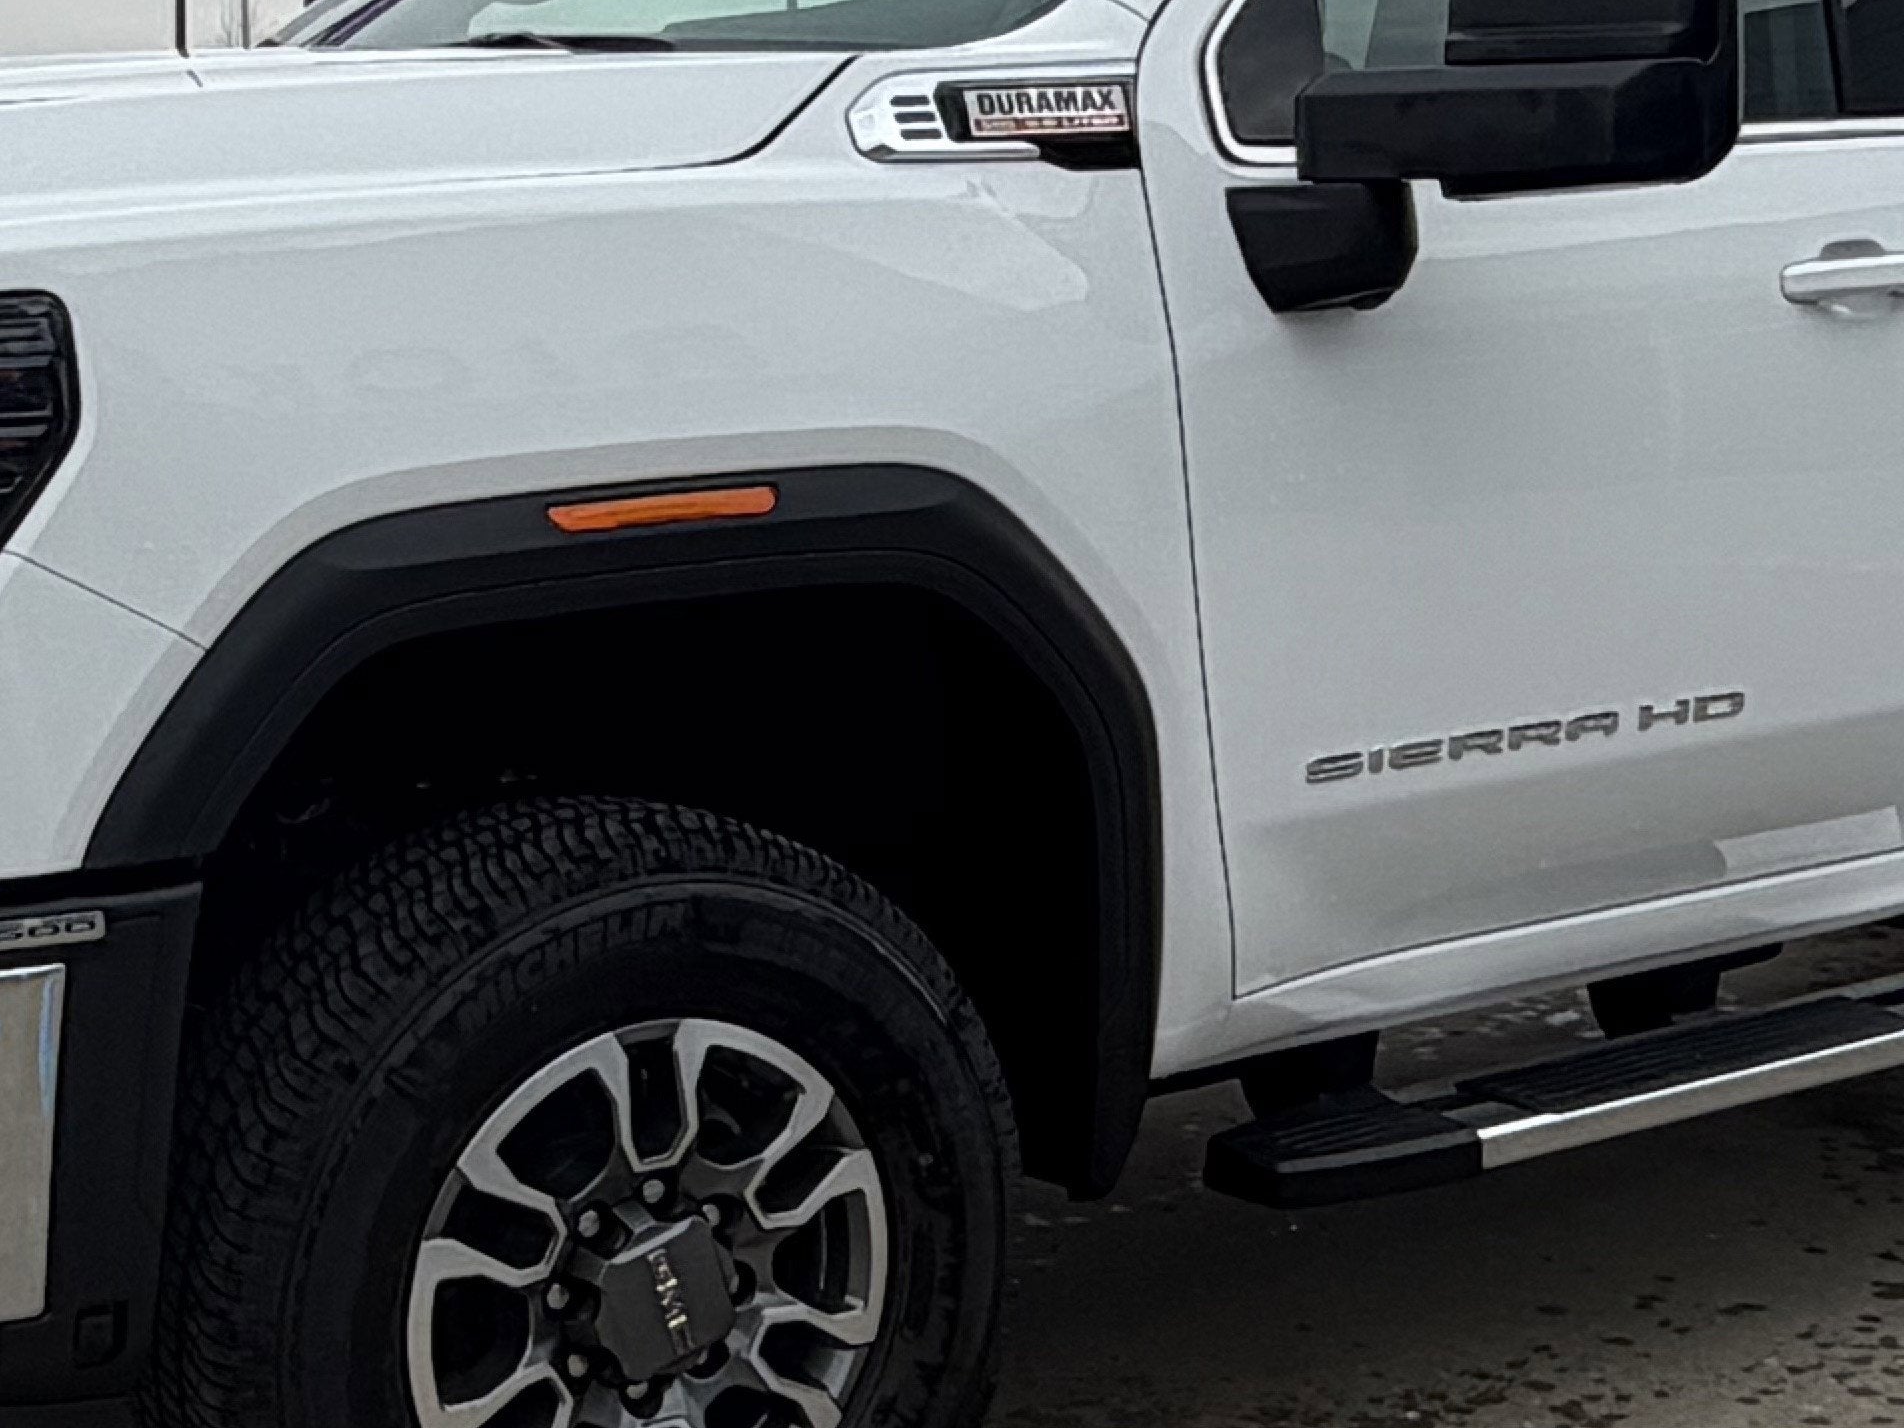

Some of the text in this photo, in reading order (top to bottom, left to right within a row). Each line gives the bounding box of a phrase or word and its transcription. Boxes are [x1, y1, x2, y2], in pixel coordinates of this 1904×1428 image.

[976, 89, 1117, 116] DURAMAX
[1305, 690, 1746, 784] SIERRA HD
